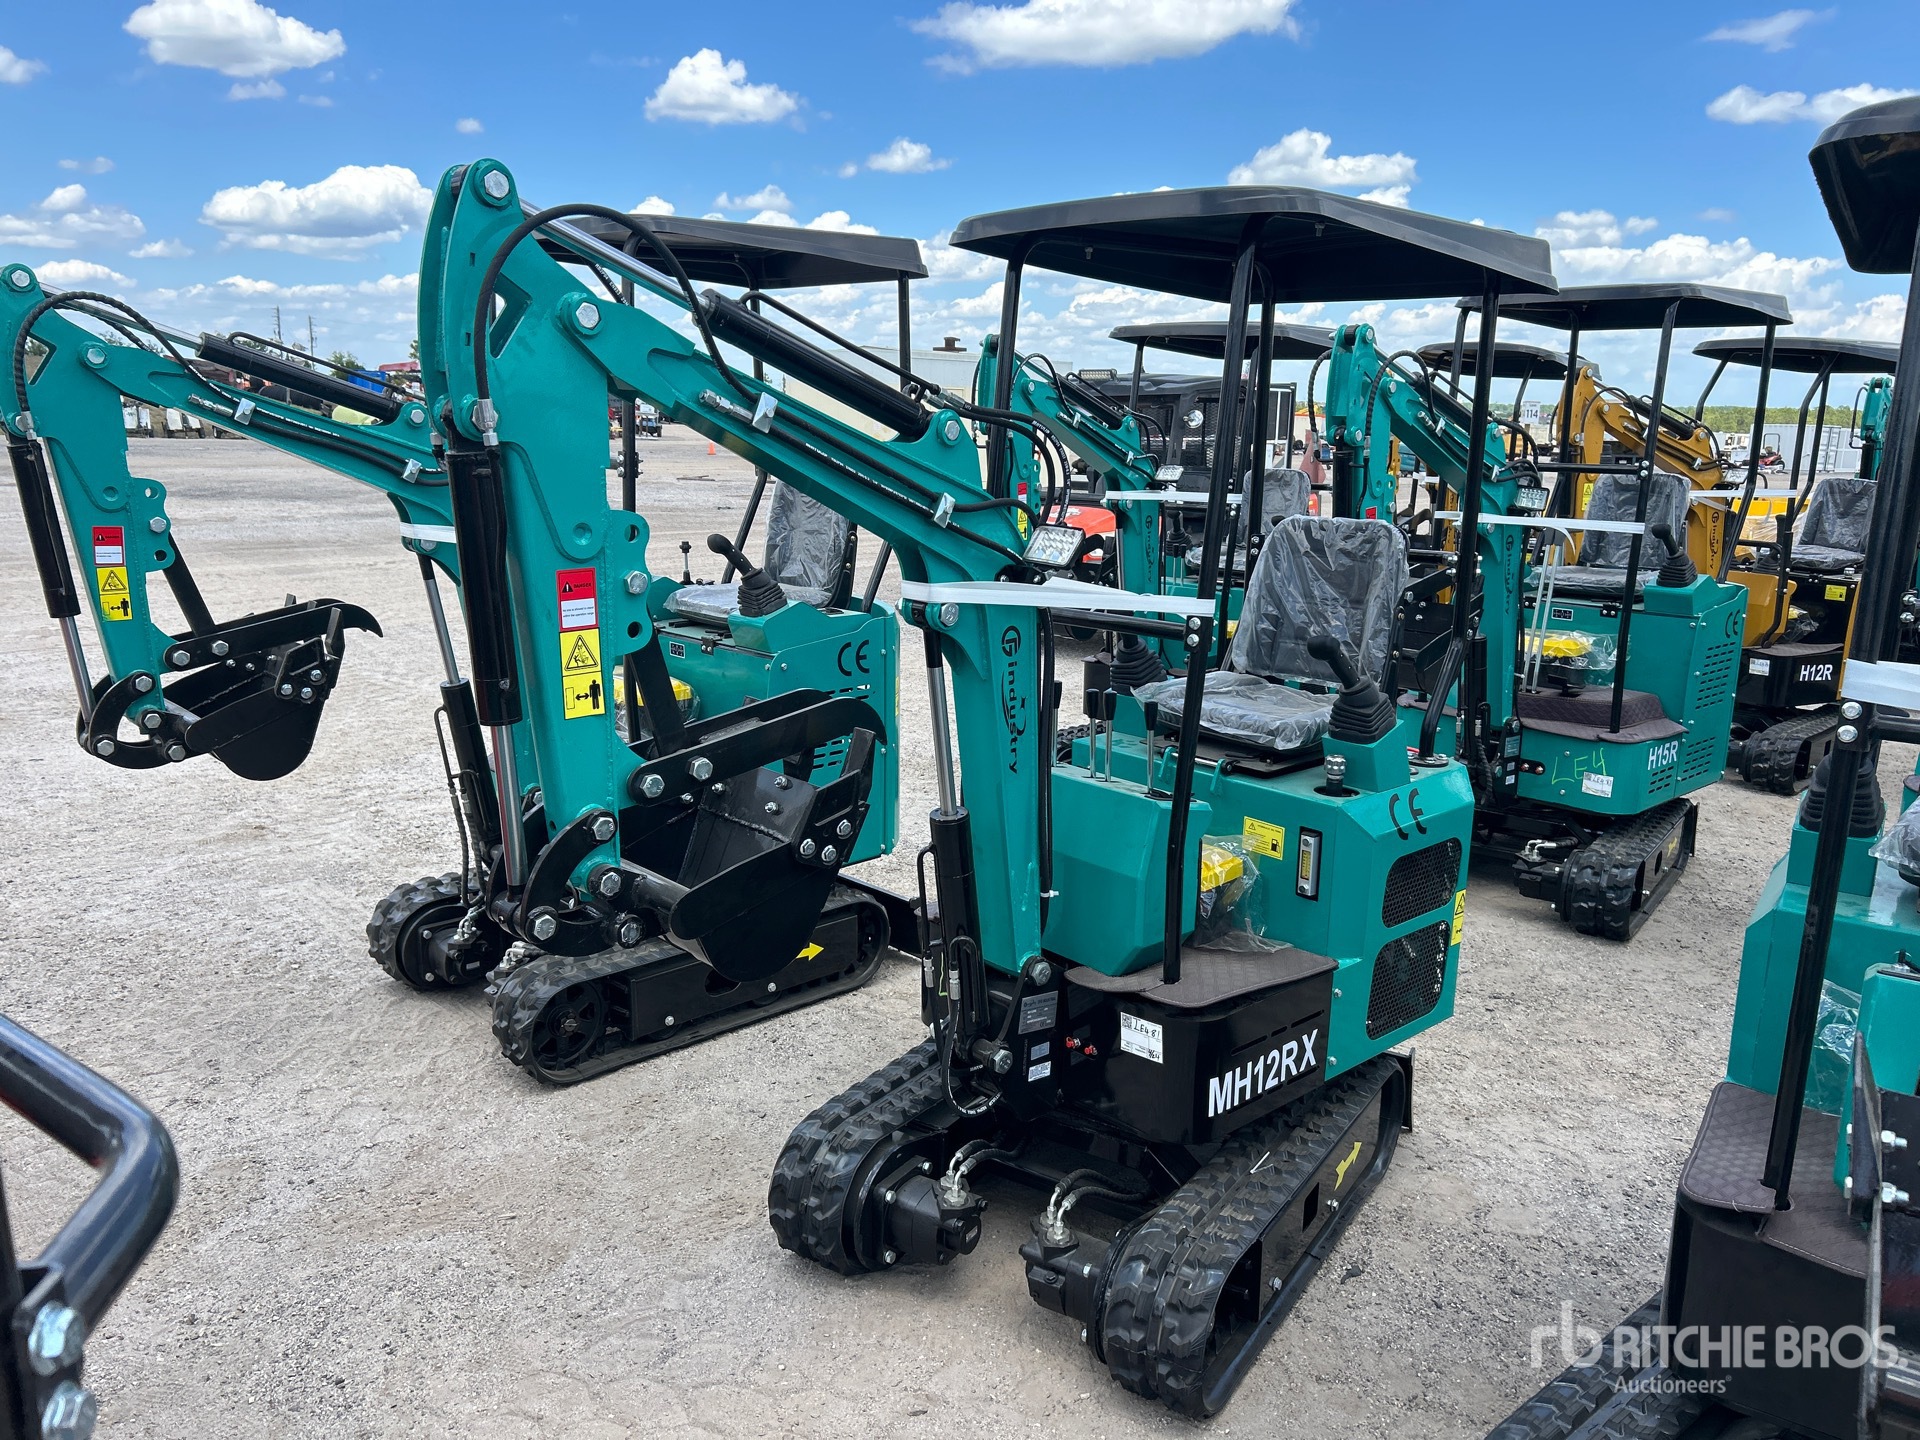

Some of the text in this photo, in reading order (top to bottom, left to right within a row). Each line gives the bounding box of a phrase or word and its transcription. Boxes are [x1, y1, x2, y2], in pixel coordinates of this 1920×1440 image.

[1526, 409, 1538, 419] 114
[837, 639, 870, 677] CE
[1800, 664, 1833, 682] H12R
[1647, 740, 1679, 771] H15R
[1388, 787, 1427, 841] CE
[1208, 1028, 1318, 1118] MH12RX
